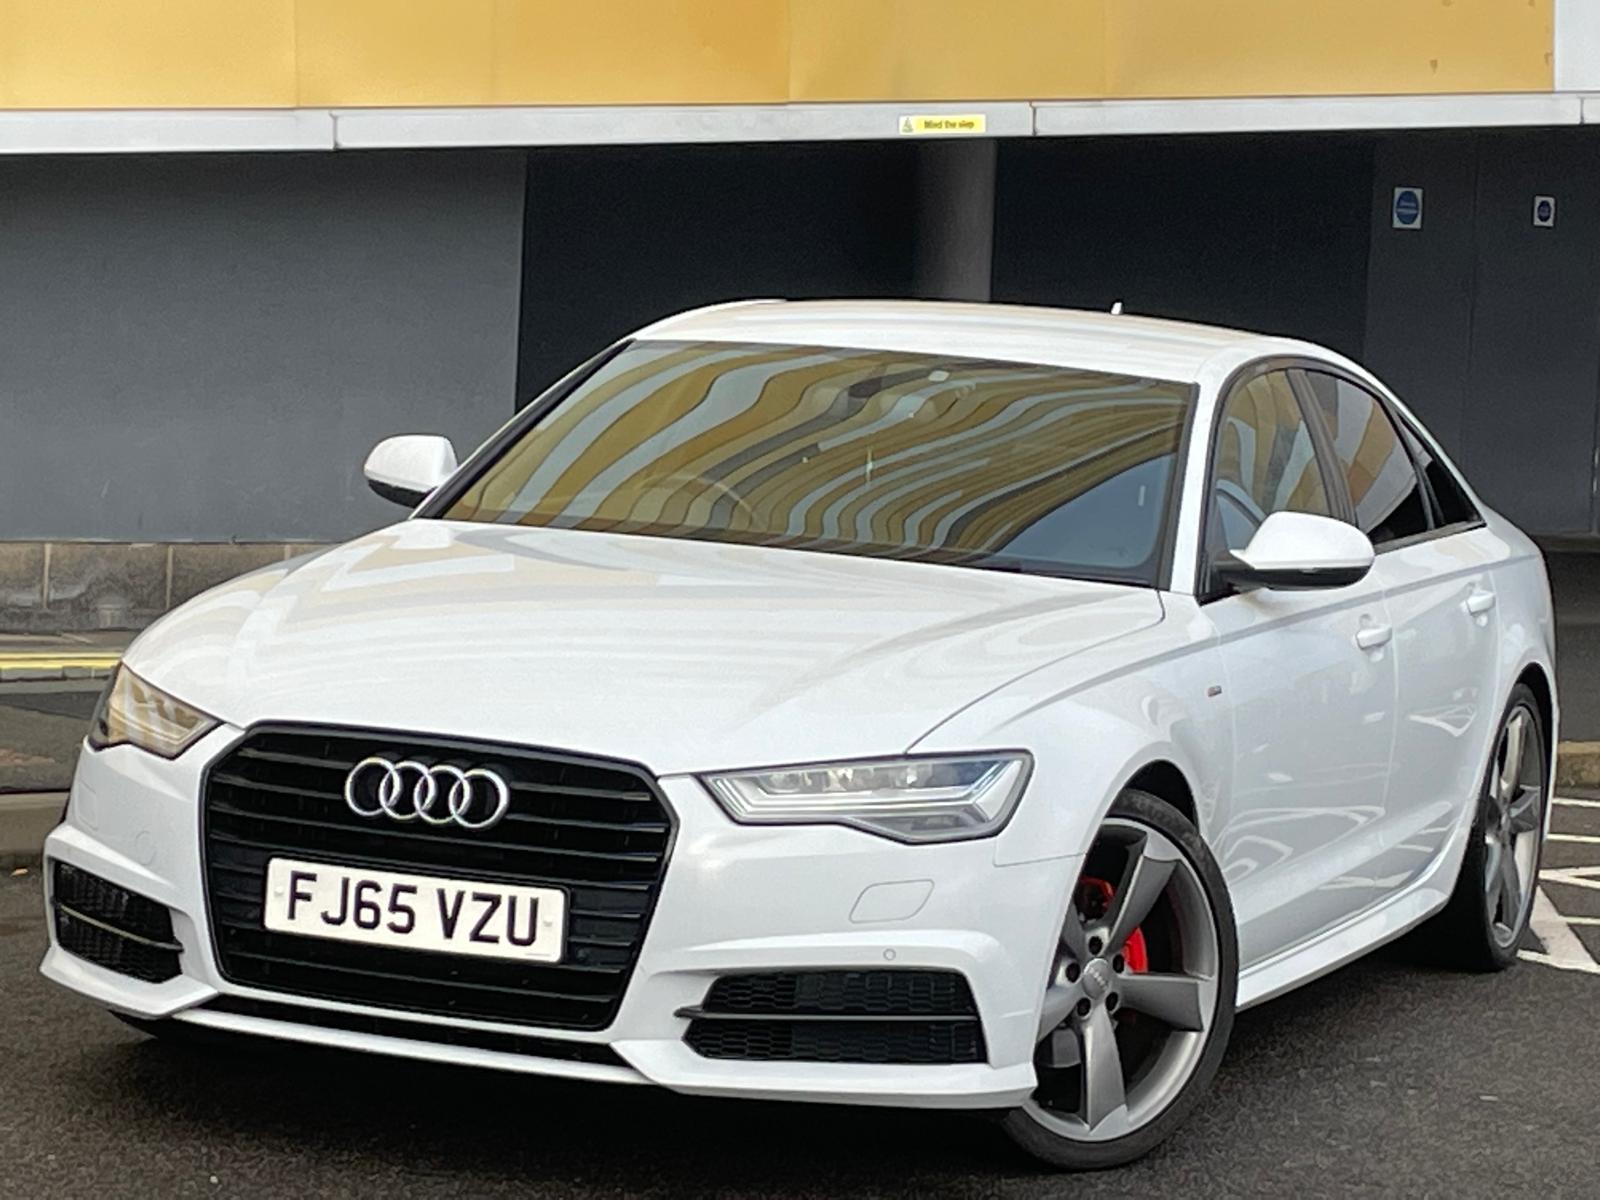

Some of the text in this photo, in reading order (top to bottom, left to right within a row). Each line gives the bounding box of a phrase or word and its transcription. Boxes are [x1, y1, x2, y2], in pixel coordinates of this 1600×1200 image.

[945, 120, 956, 129] the
[287, 870, 539, 947] FJ65 VZU
